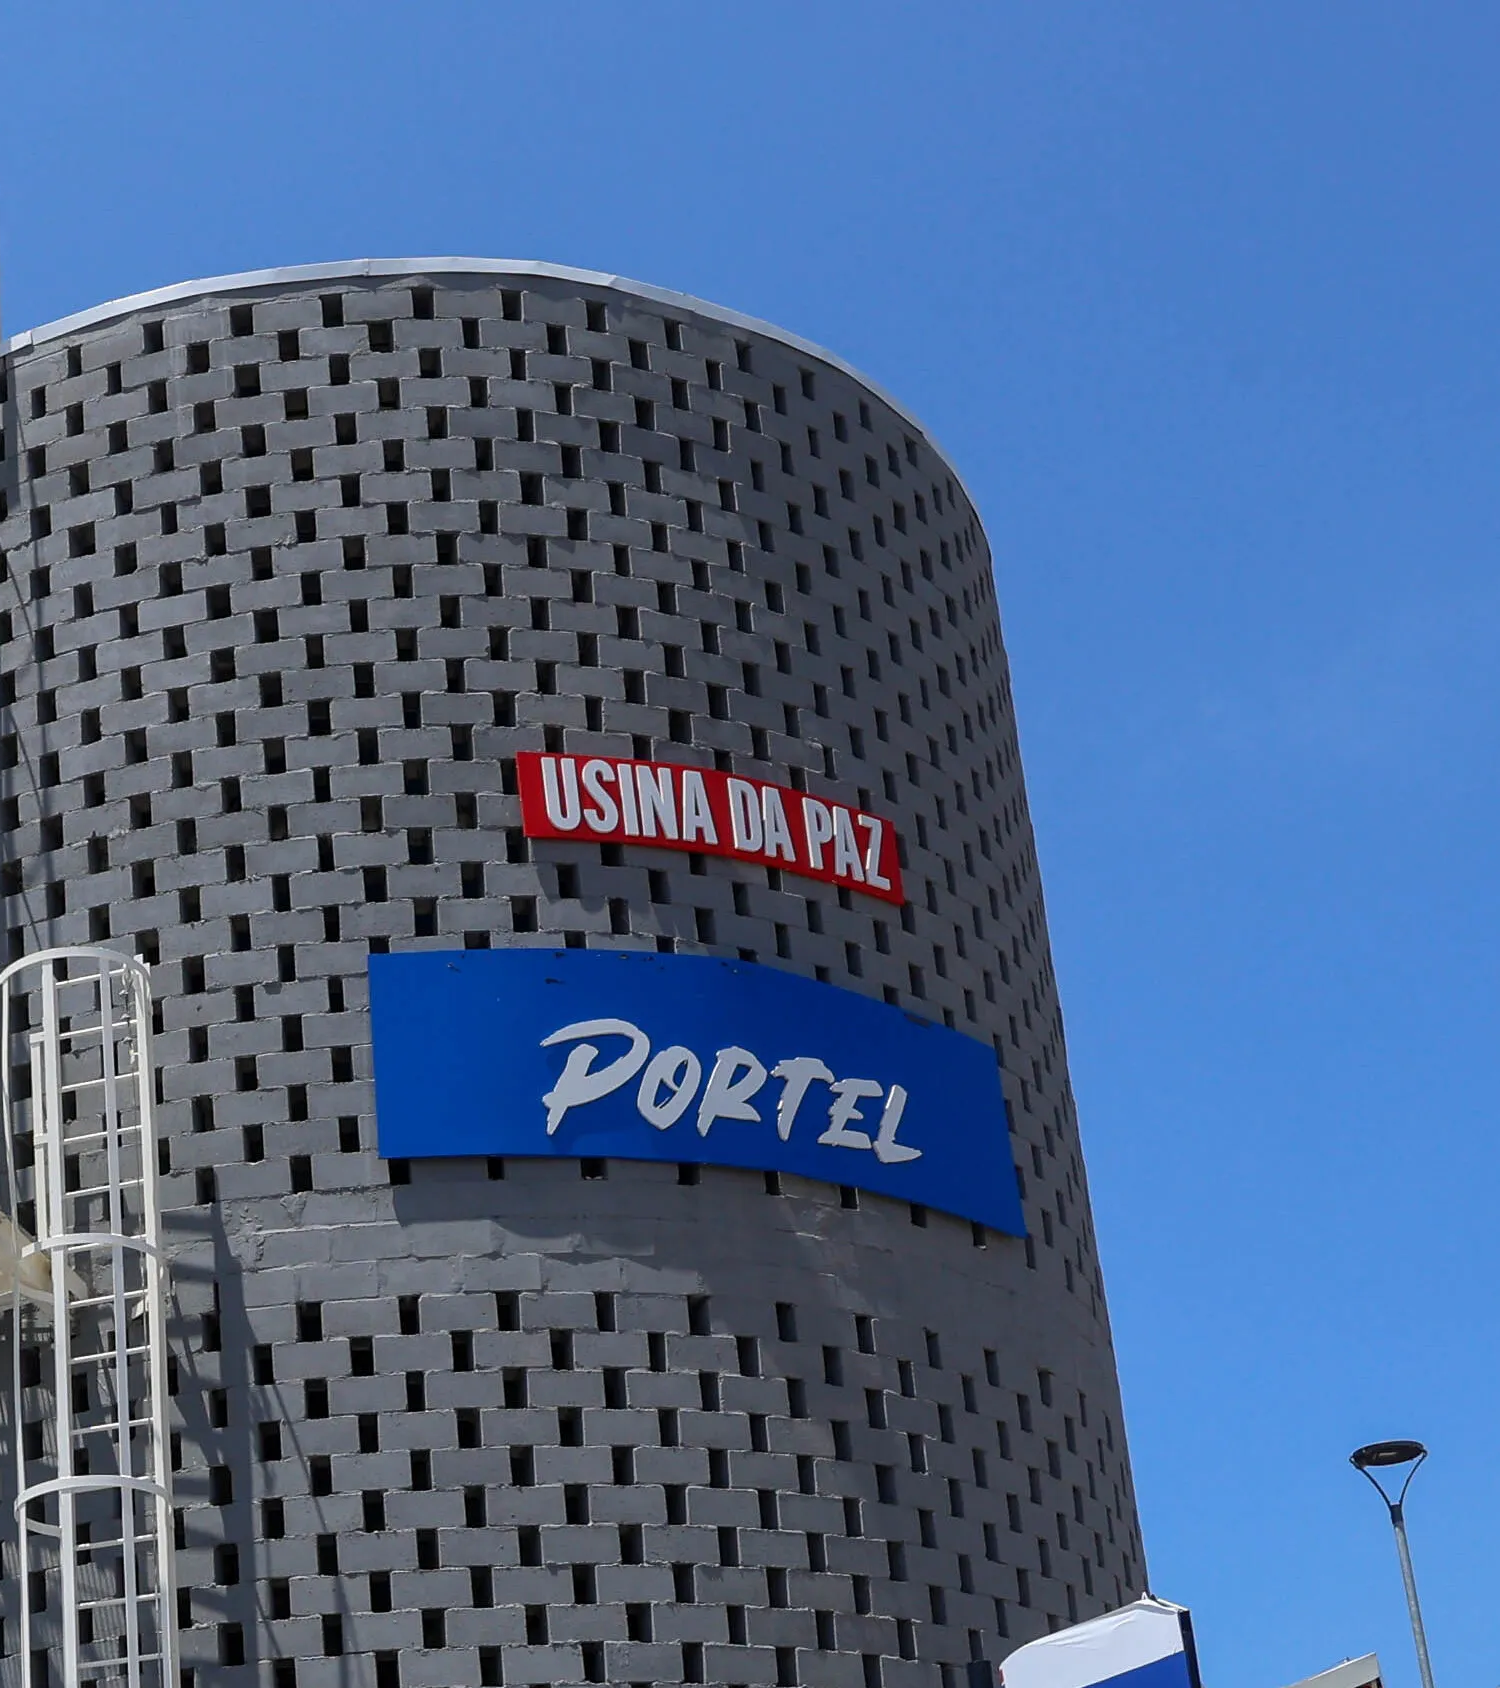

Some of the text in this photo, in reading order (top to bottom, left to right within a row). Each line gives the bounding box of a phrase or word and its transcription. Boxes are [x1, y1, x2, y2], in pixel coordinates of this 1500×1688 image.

[541, 757, 891, 891] USINA DA PAZ
[540, 1018, 923, 1163] PORTEL
